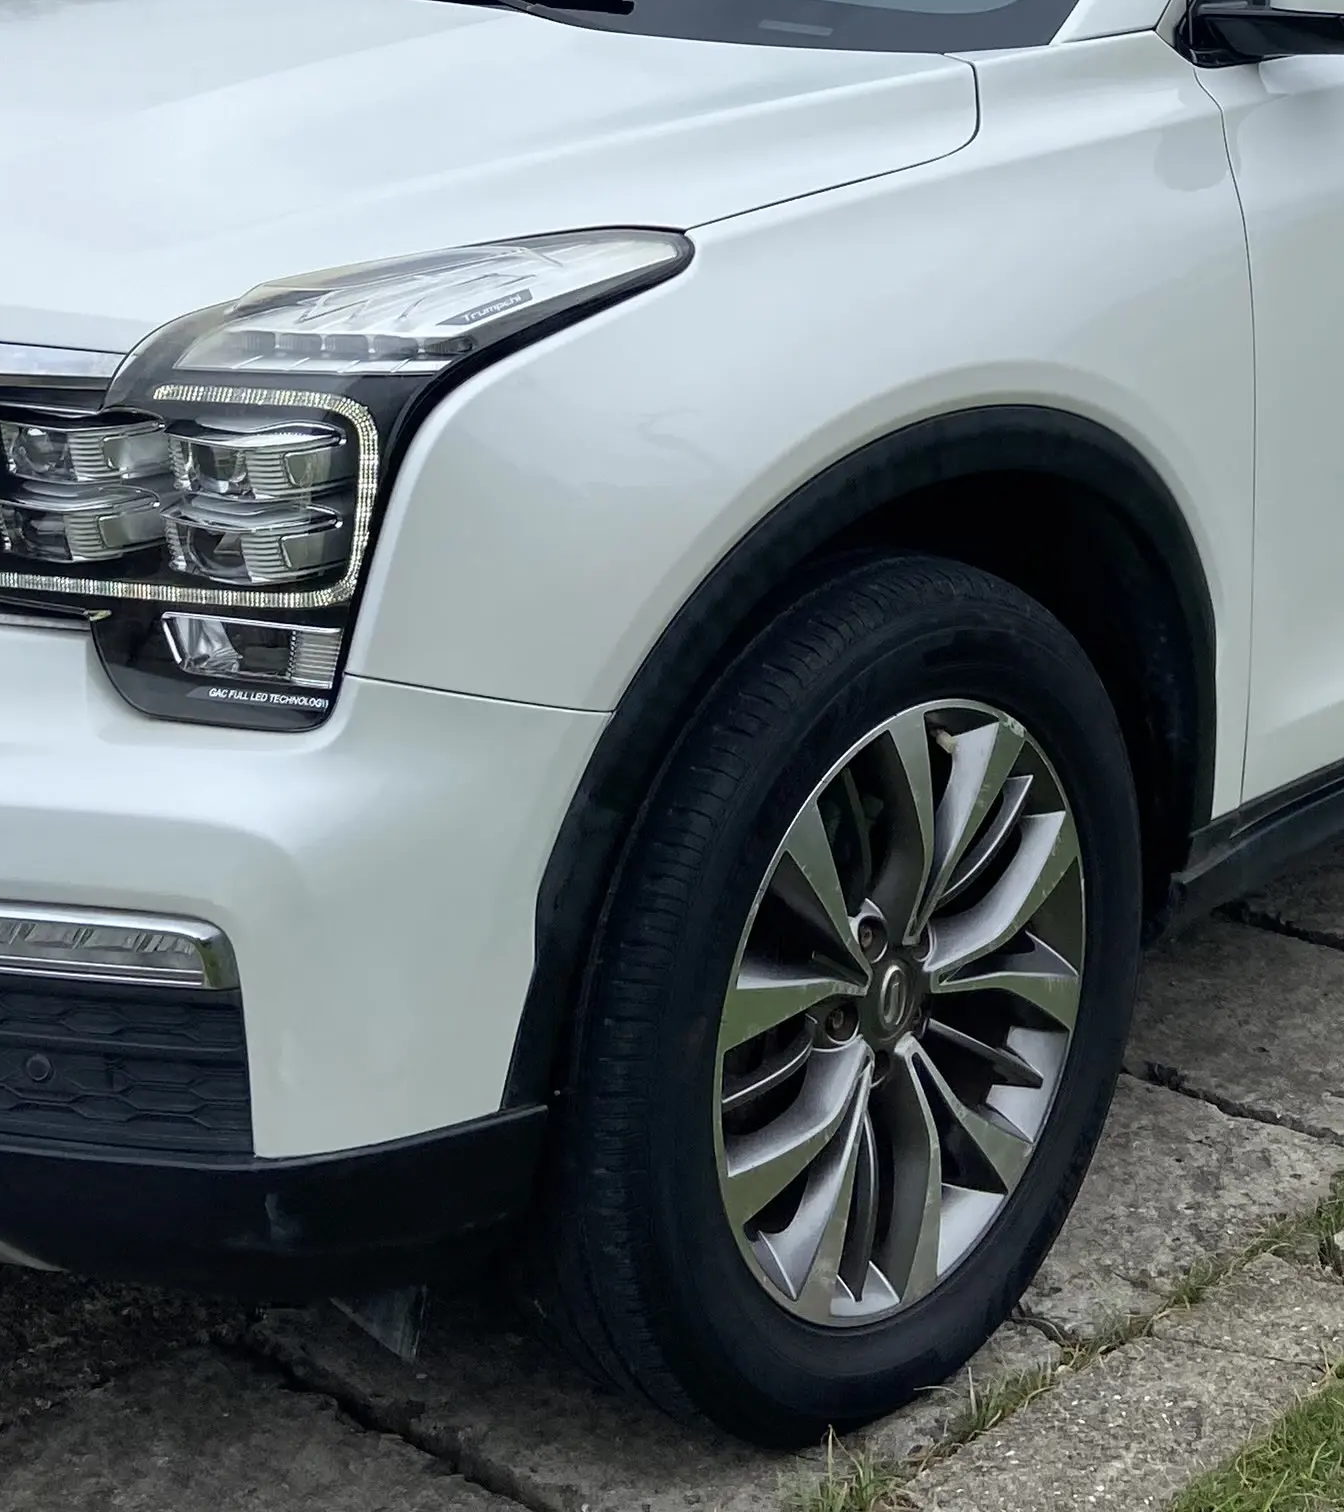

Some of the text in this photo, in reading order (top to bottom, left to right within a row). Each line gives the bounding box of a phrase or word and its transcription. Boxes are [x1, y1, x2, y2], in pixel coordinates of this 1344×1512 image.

[463, 294, 522, 322] Trumpchi
[208, 687, 228, 698] GAC
[228, 690, 249, 700] FULL
[250, 692, 268, 702] LED
